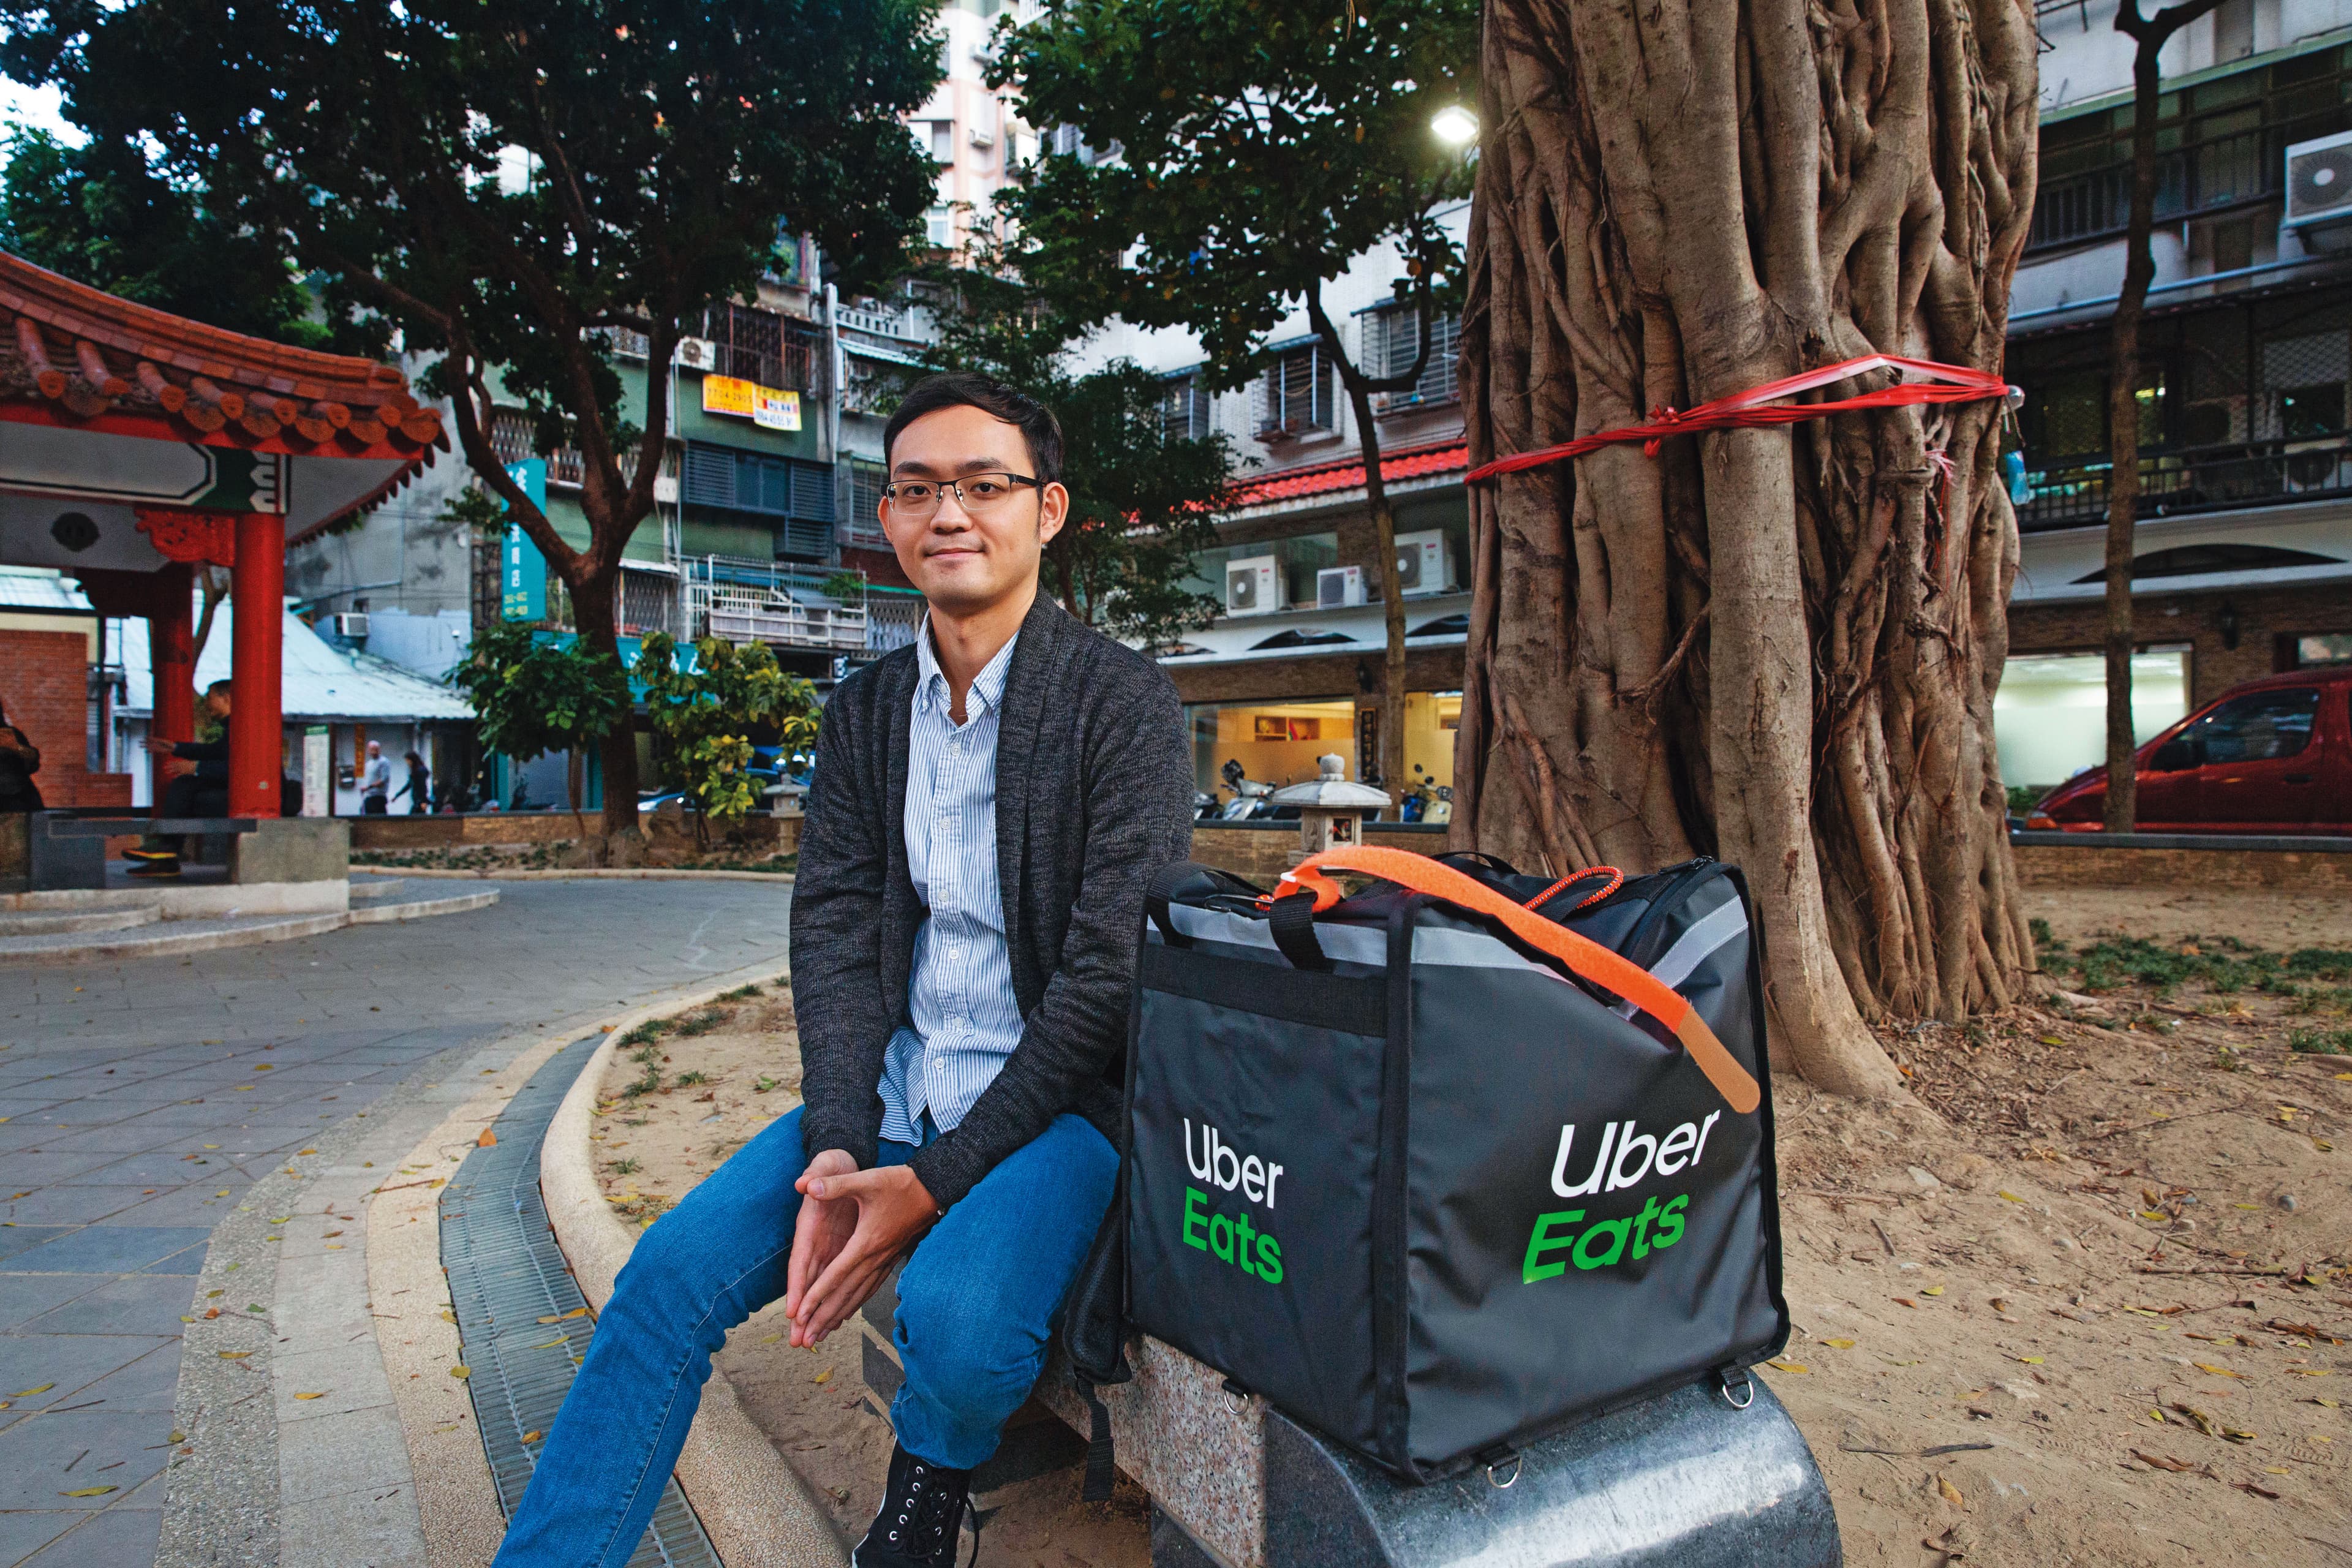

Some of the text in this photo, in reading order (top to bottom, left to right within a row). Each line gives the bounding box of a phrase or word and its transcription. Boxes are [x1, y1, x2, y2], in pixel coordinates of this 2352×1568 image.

[1183, 1118, 1284, 1209] Uber
[1551, 1109, 1721, 1197] Uber
[1182, 1185, 1284, 1284] Eats
[1521, 1193, 1689, 1284] Eats
